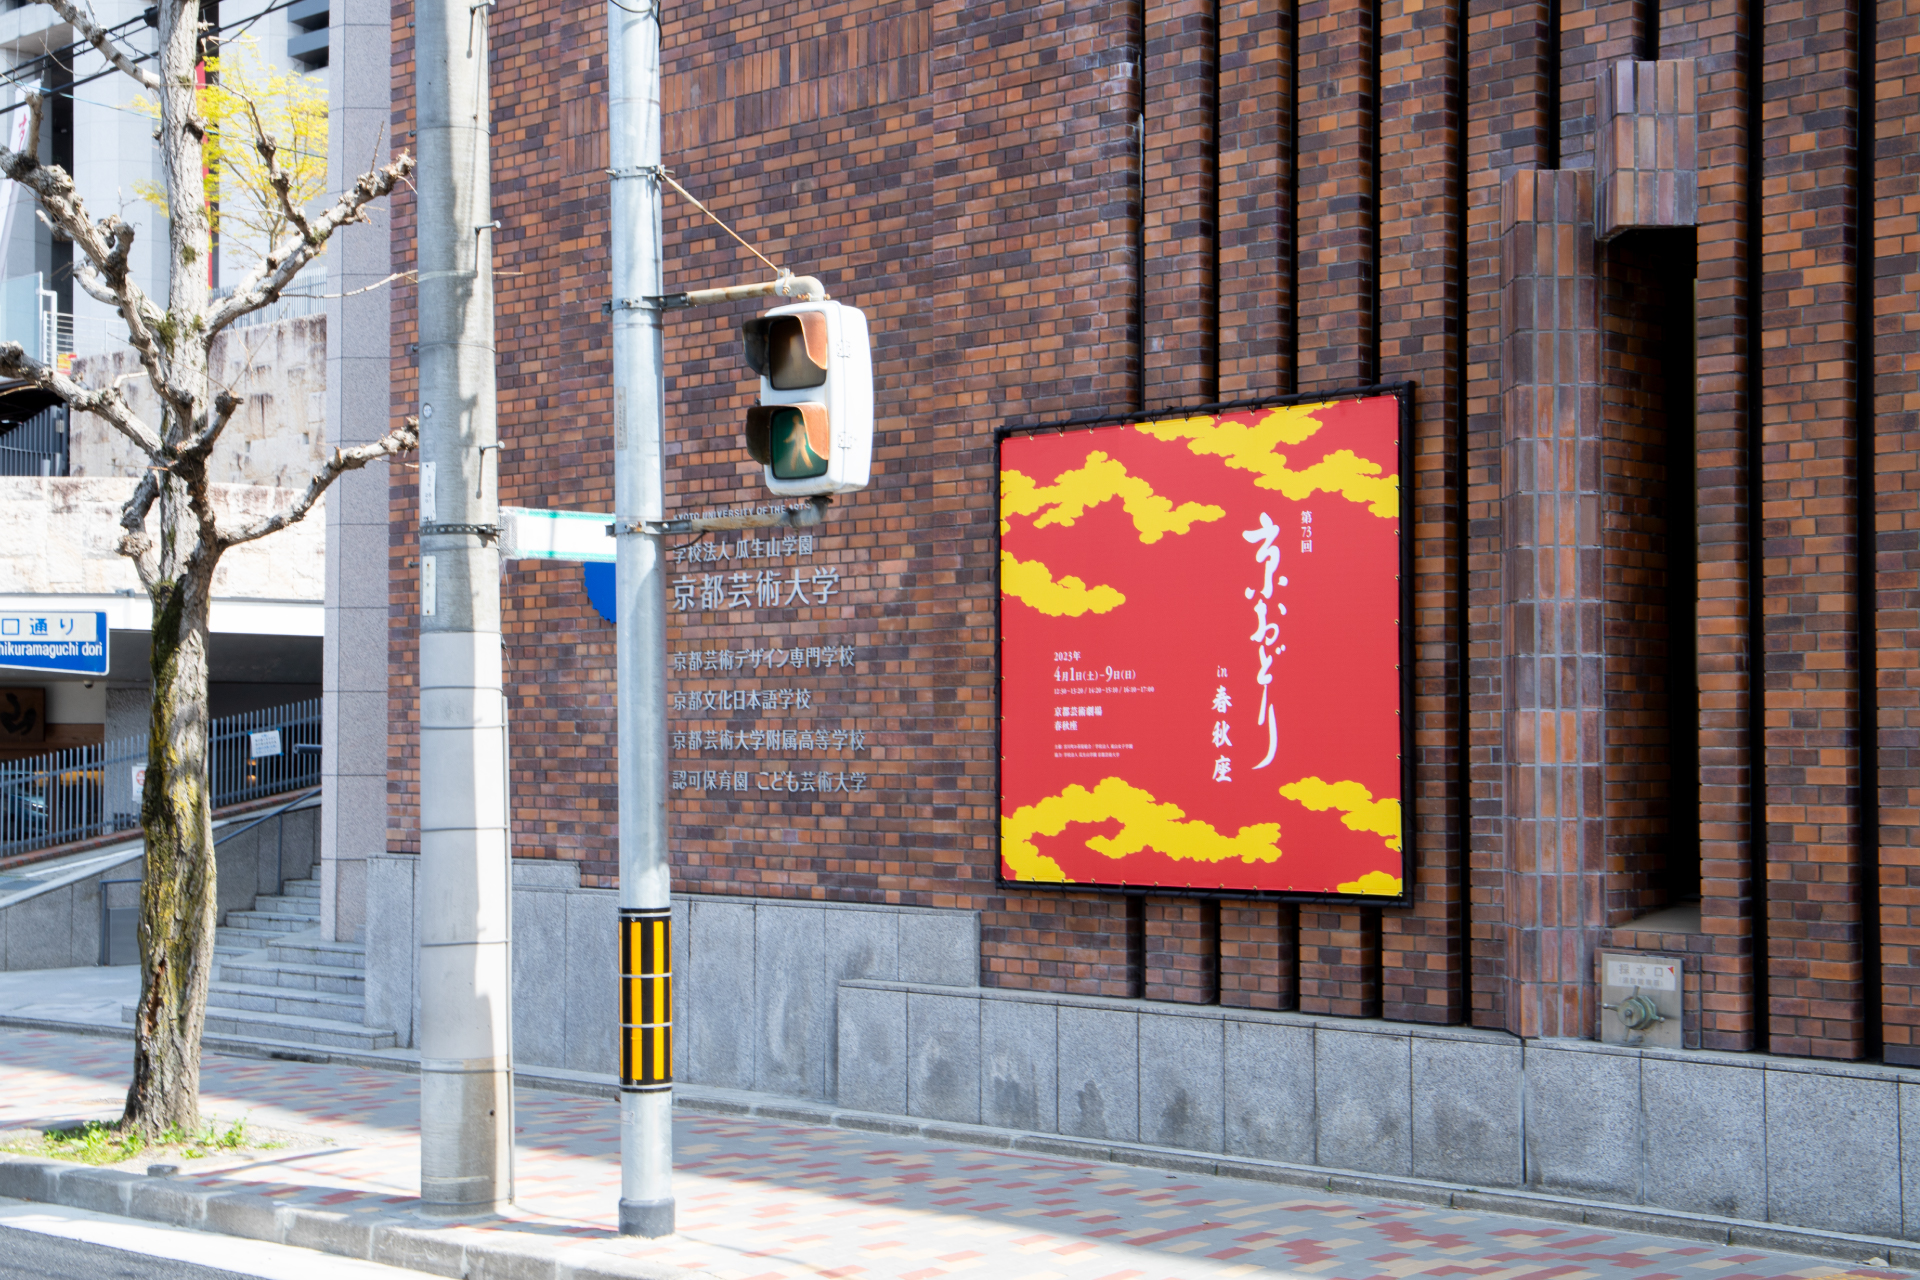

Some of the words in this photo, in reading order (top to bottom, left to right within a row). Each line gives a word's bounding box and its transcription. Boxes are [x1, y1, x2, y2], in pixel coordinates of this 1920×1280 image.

[702, 508, 754, 519] UNIVERSITY
[756, 506, 768, 515] OF
[770, 504, 786, 514] THE
[1301, 510, 1313, 553] 第73回
[673, 541, 730, 564] 学校法人
[736, 535, 813, 560] 瓜生山学園
[672, 567, 840, 611] 京都芸術大学
[2, 618, 74, 636] 口通り
[82, 642, 103, 656] dori
[1242, 512, 1288, 770] 京おどり
[673, 645, 855, 672] 京都芸術デザイン専門学校
[1054, 650, 1081, 662] 2023年
[1216, 665, 1228, 678] in
[673, 689, 811, 711] 京都文化日本語学校
[1054, 706, 1103, 717] 京都芸術劇場
[1054, 720, 1078, 731] 春秋座
[1211, 685, 1233, 782] 春秋座
[672, 729, 866, 751] 京都芸術大学附属高等学校
[672, 770, 748, 791] 認可保育園
[757, 771, 867, 793] こども芸術大学
